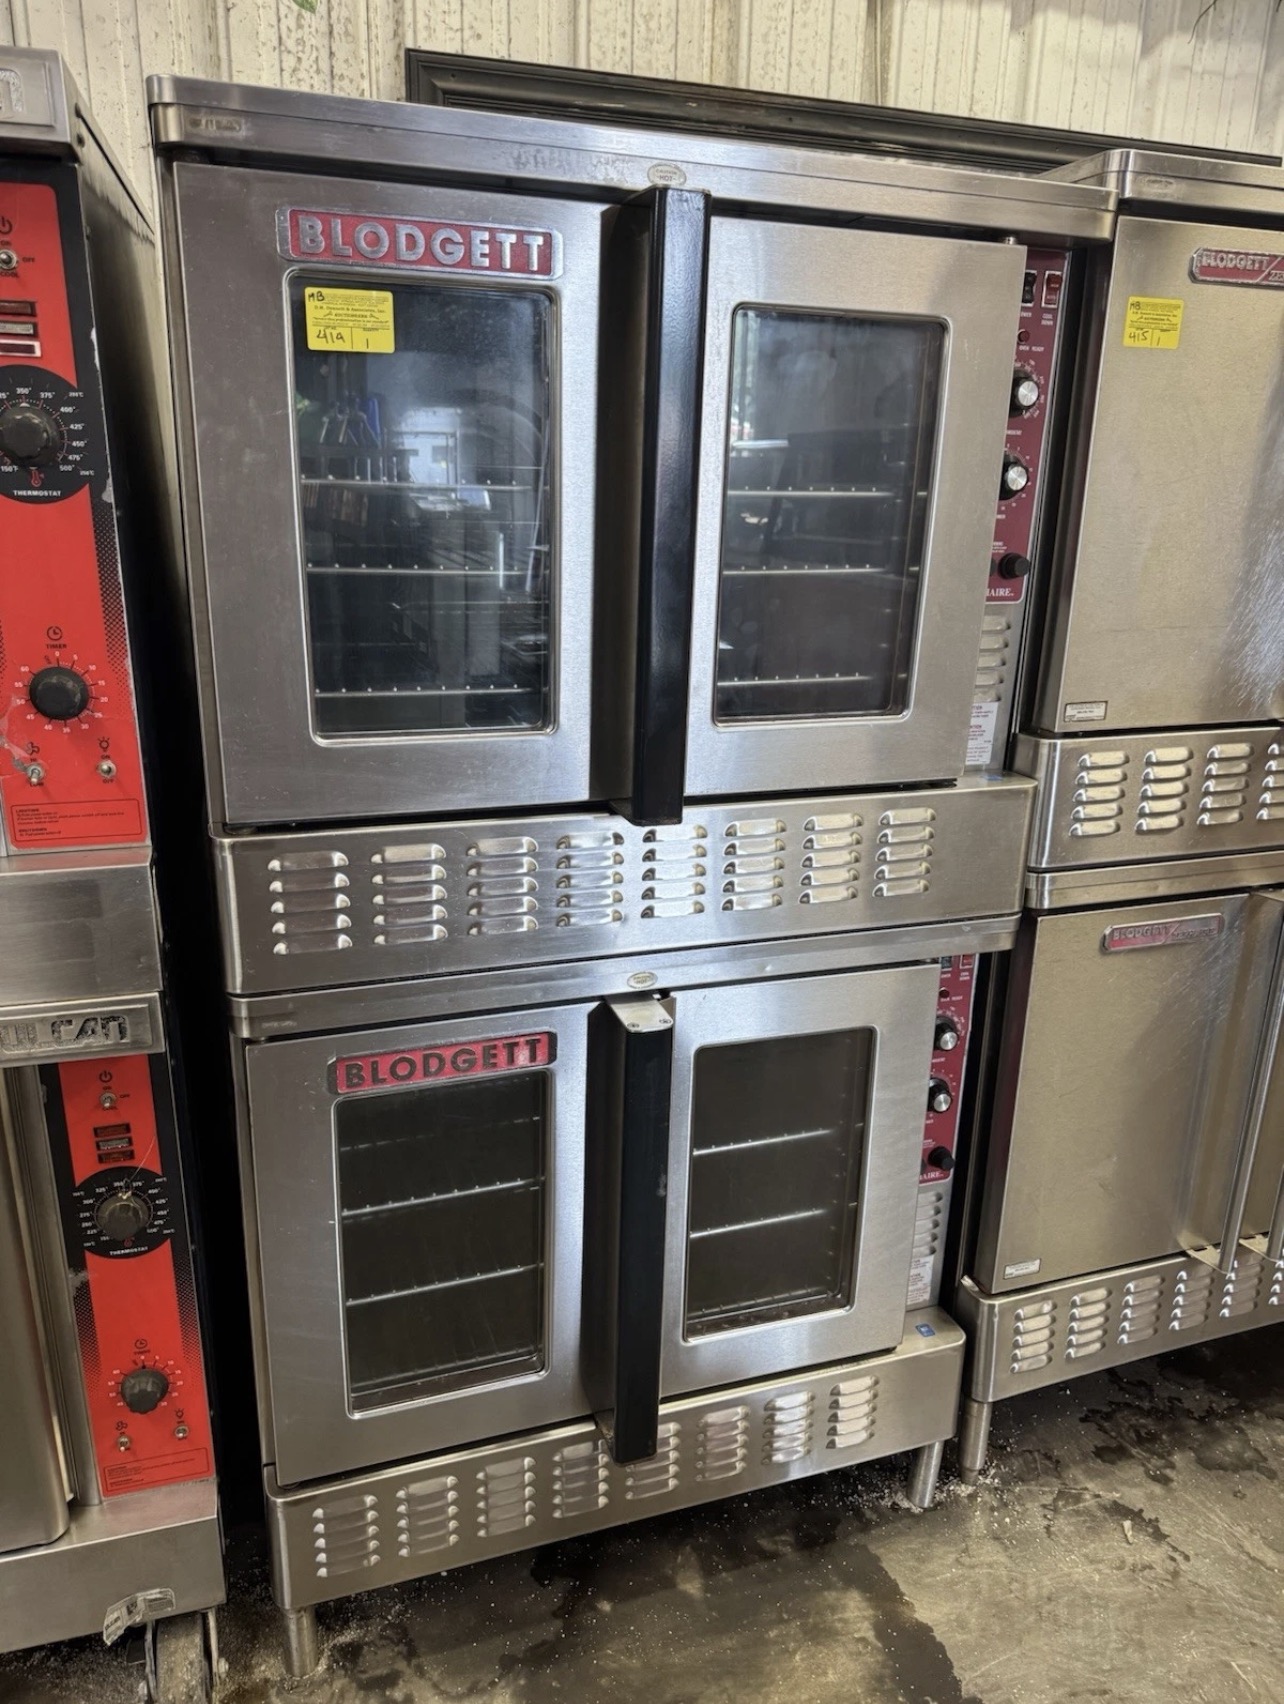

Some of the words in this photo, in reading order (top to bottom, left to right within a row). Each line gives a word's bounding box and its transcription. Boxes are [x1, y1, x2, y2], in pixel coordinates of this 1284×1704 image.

[299, 215, 544, 271] BLODGETT
[1201, 251, 1269, 271] BLODGETT
[1129, 330, 1149, 343] 415
[345, 1038, 542, 1088] BLODGETT
